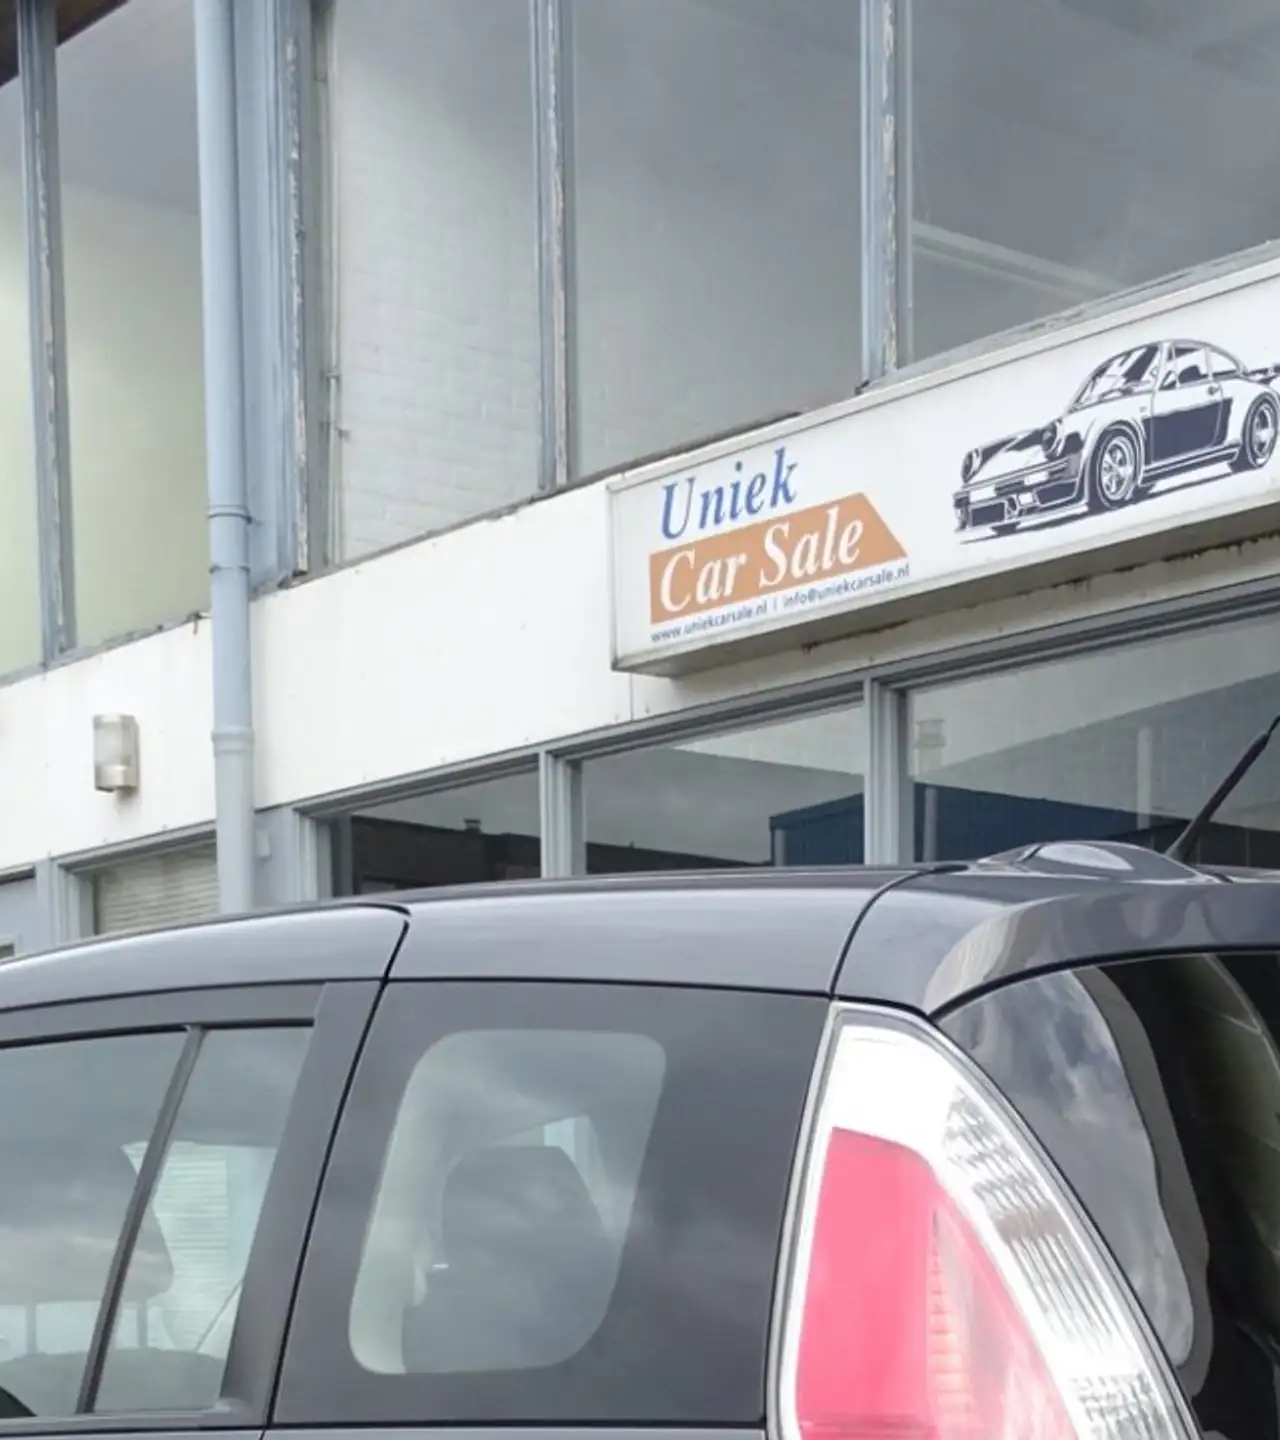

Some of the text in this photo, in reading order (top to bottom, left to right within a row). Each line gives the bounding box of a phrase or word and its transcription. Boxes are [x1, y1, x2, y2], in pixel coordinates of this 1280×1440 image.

[662, 446, 798, 540] Uniek
[650, 602, 767, 643] www.uniekcarsale.nl
[782, 563, 910, 609] info@uniekcarsale.nl
[660, 506, 864, 612] Car Sale
